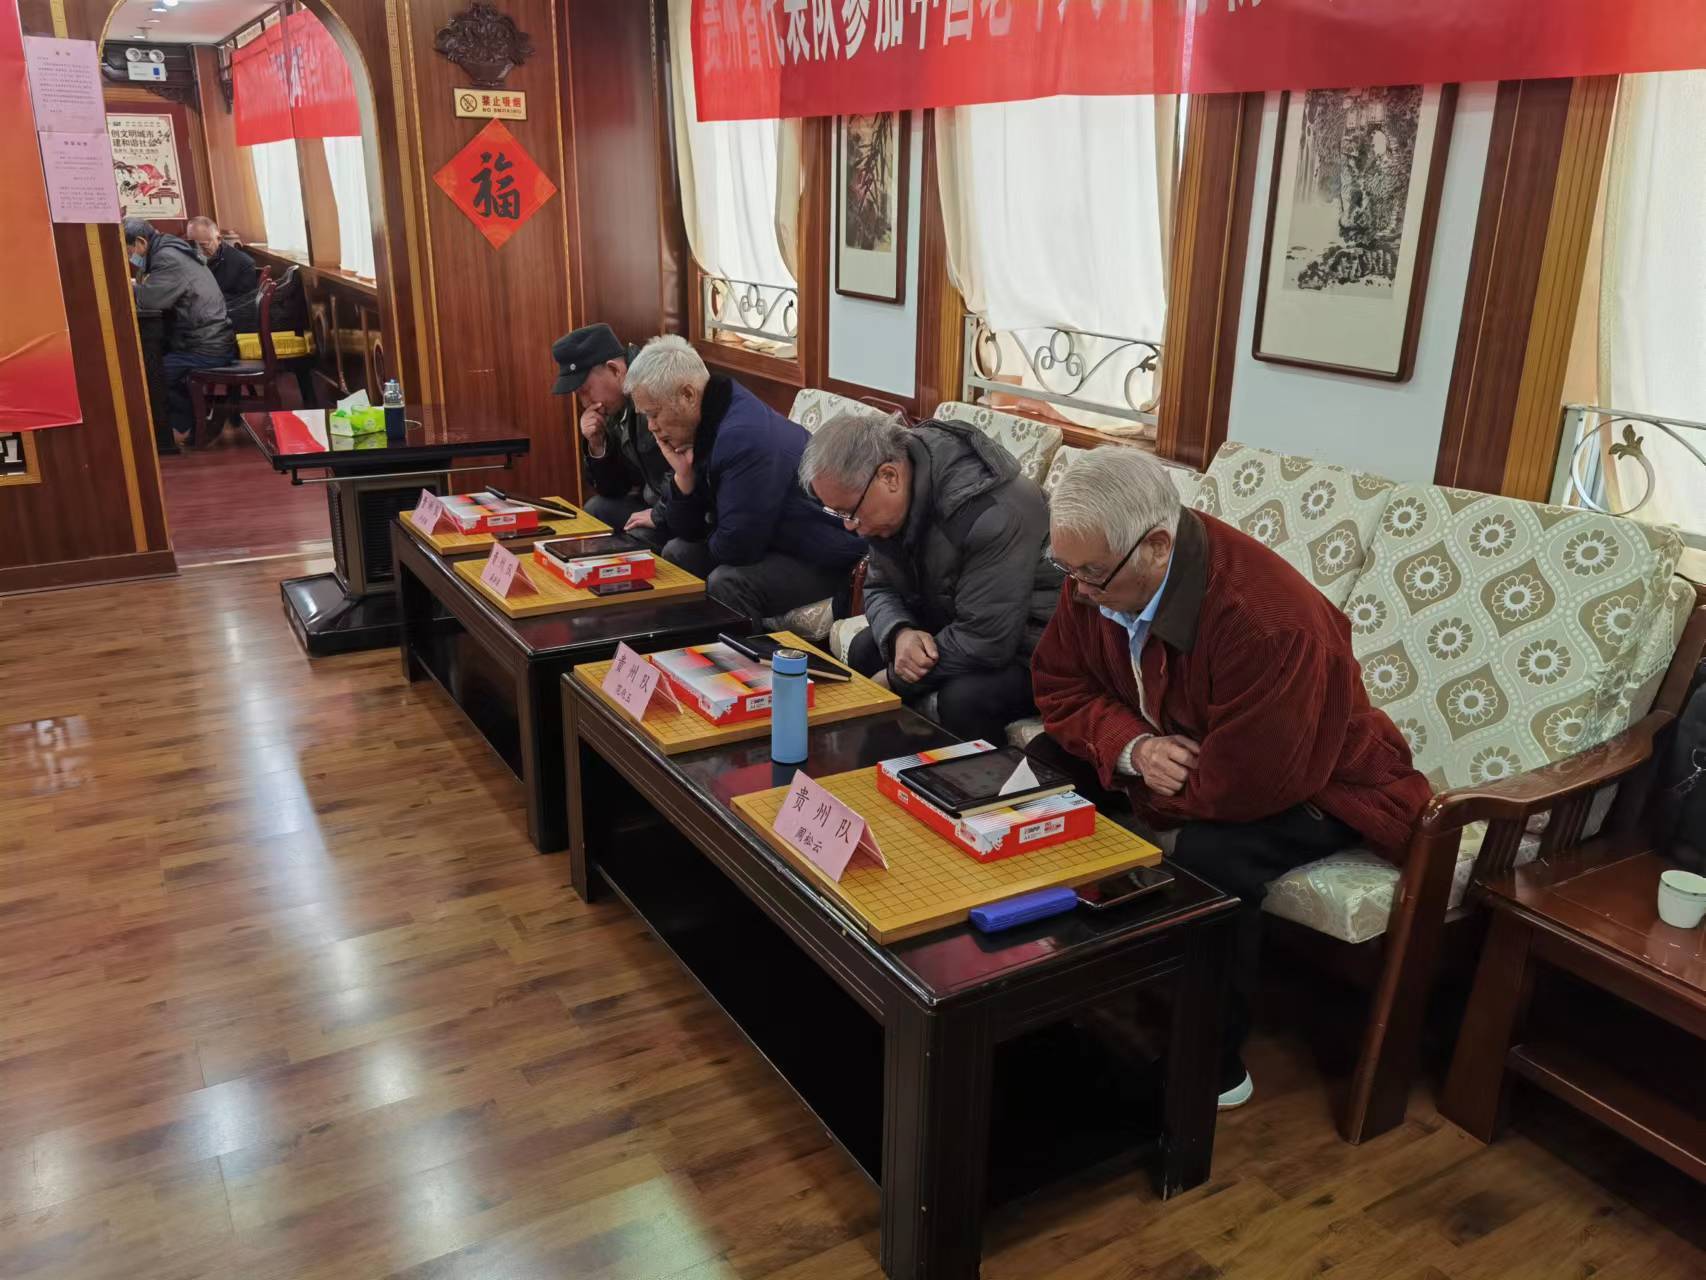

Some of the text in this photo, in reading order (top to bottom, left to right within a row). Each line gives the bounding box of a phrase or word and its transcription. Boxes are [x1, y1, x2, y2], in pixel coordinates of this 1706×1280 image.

[111, 129, 154, 139] 创文明城市
[470, 151, 521, 220] 福
[791, 785, 852, 844] 贵州队
